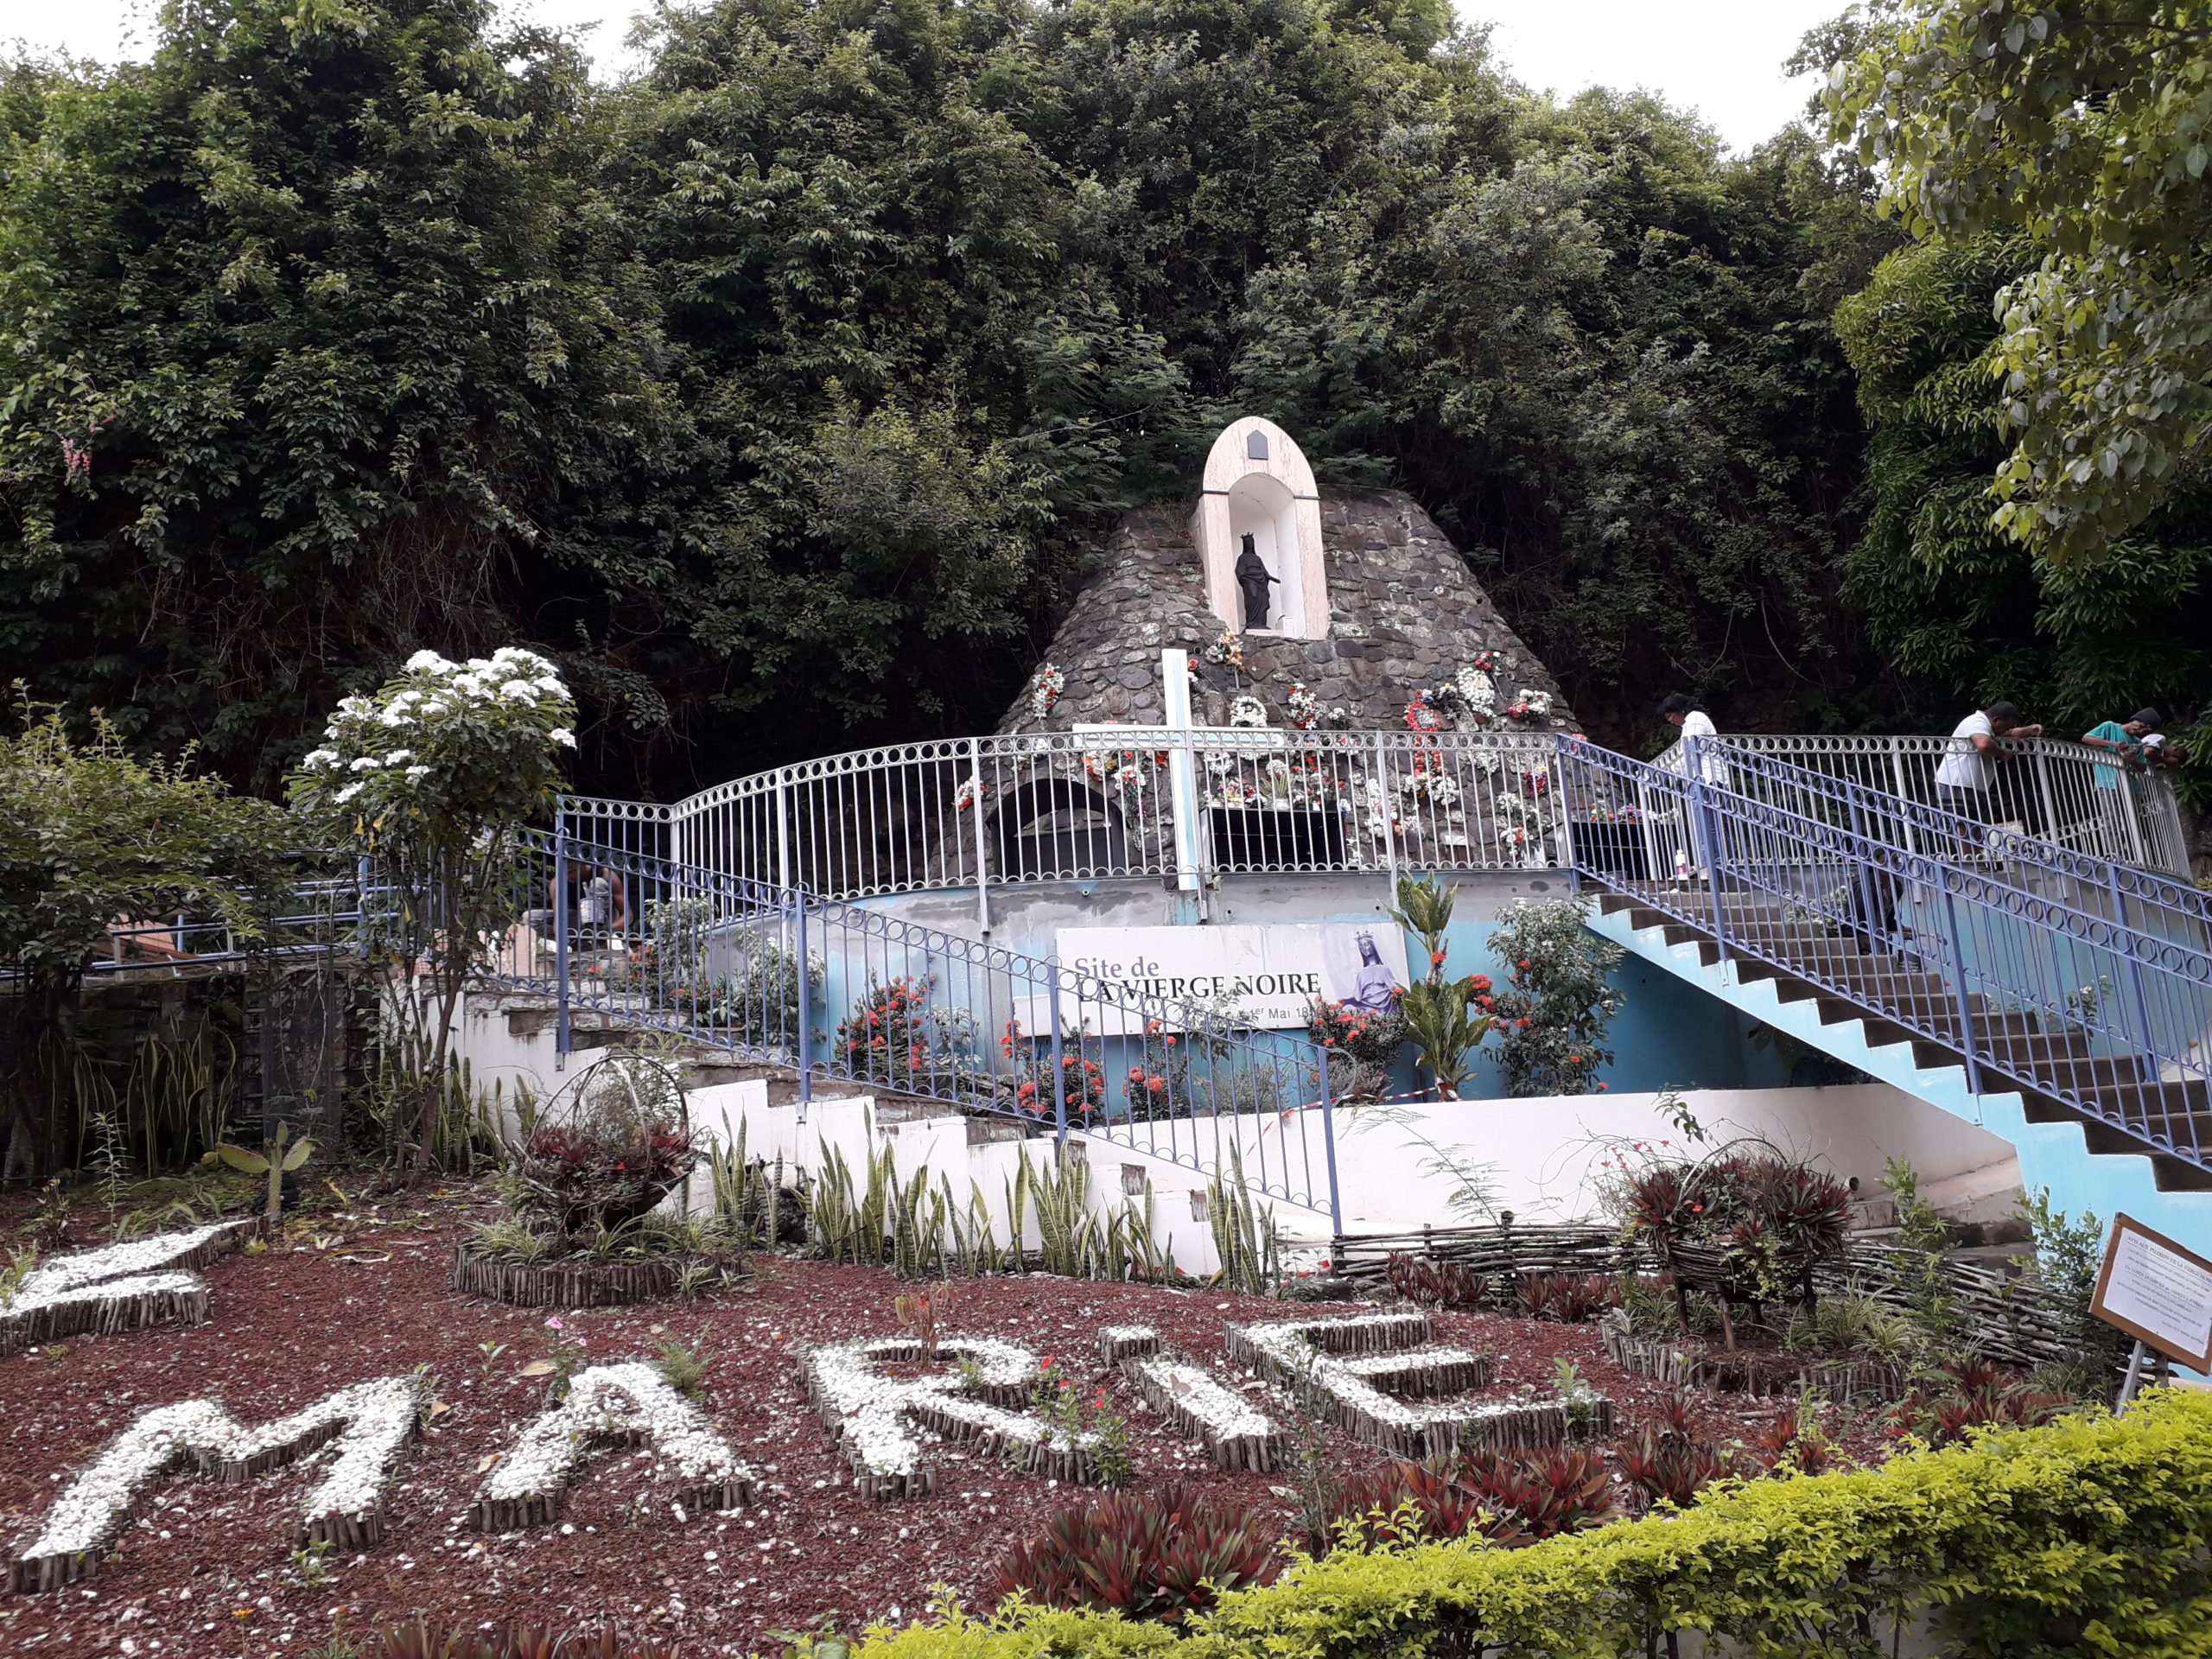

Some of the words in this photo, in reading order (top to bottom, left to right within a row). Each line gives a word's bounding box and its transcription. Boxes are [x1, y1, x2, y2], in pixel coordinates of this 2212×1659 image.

[1074, 957, 1122, 979] Site
[1130, 956, 1160, 977] de
[1080, 980, 1115, 1002] LA
[1121, 976, 1225, 1001] VIERGE
[1233, 973, 1319, 996] NOIRE
[1268, 1007, 1291, 1020] Mai
